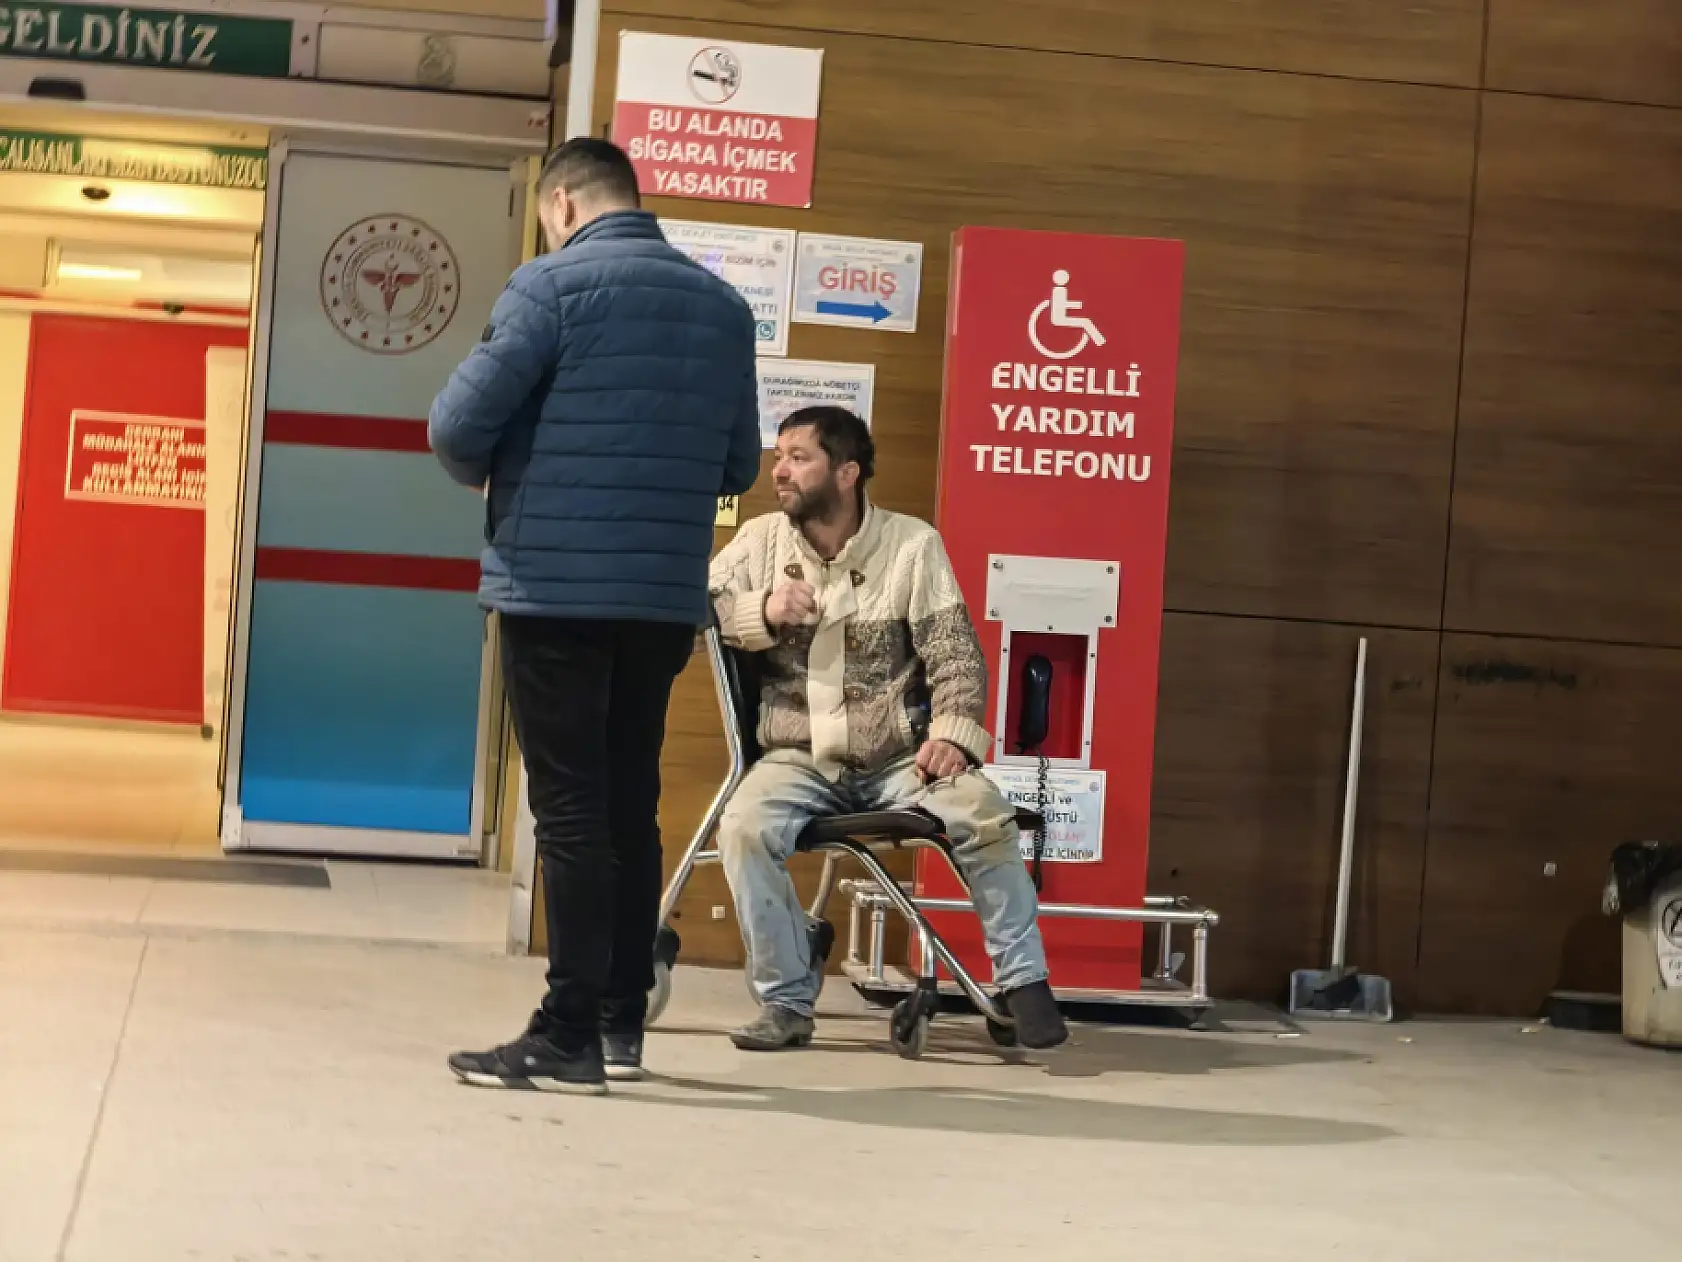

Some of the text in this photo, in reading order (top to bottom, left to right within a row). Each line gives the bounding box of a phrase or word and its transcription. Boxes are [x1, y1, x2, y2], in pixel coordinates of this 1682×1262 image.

[648, 108, 783, 142] BU ALANDA
[629, 134, 798, 174] SİGARA İÇMEK
[653, 168, 768, 200] YASAKTIR
[818, 261, 898, 301] GİRİŞ
[991, 361, 1142, 398] ENGELLİ
[991, 402, 1135, 439] YARDIM
[969, 444, 1151, 482] TELEFONU
